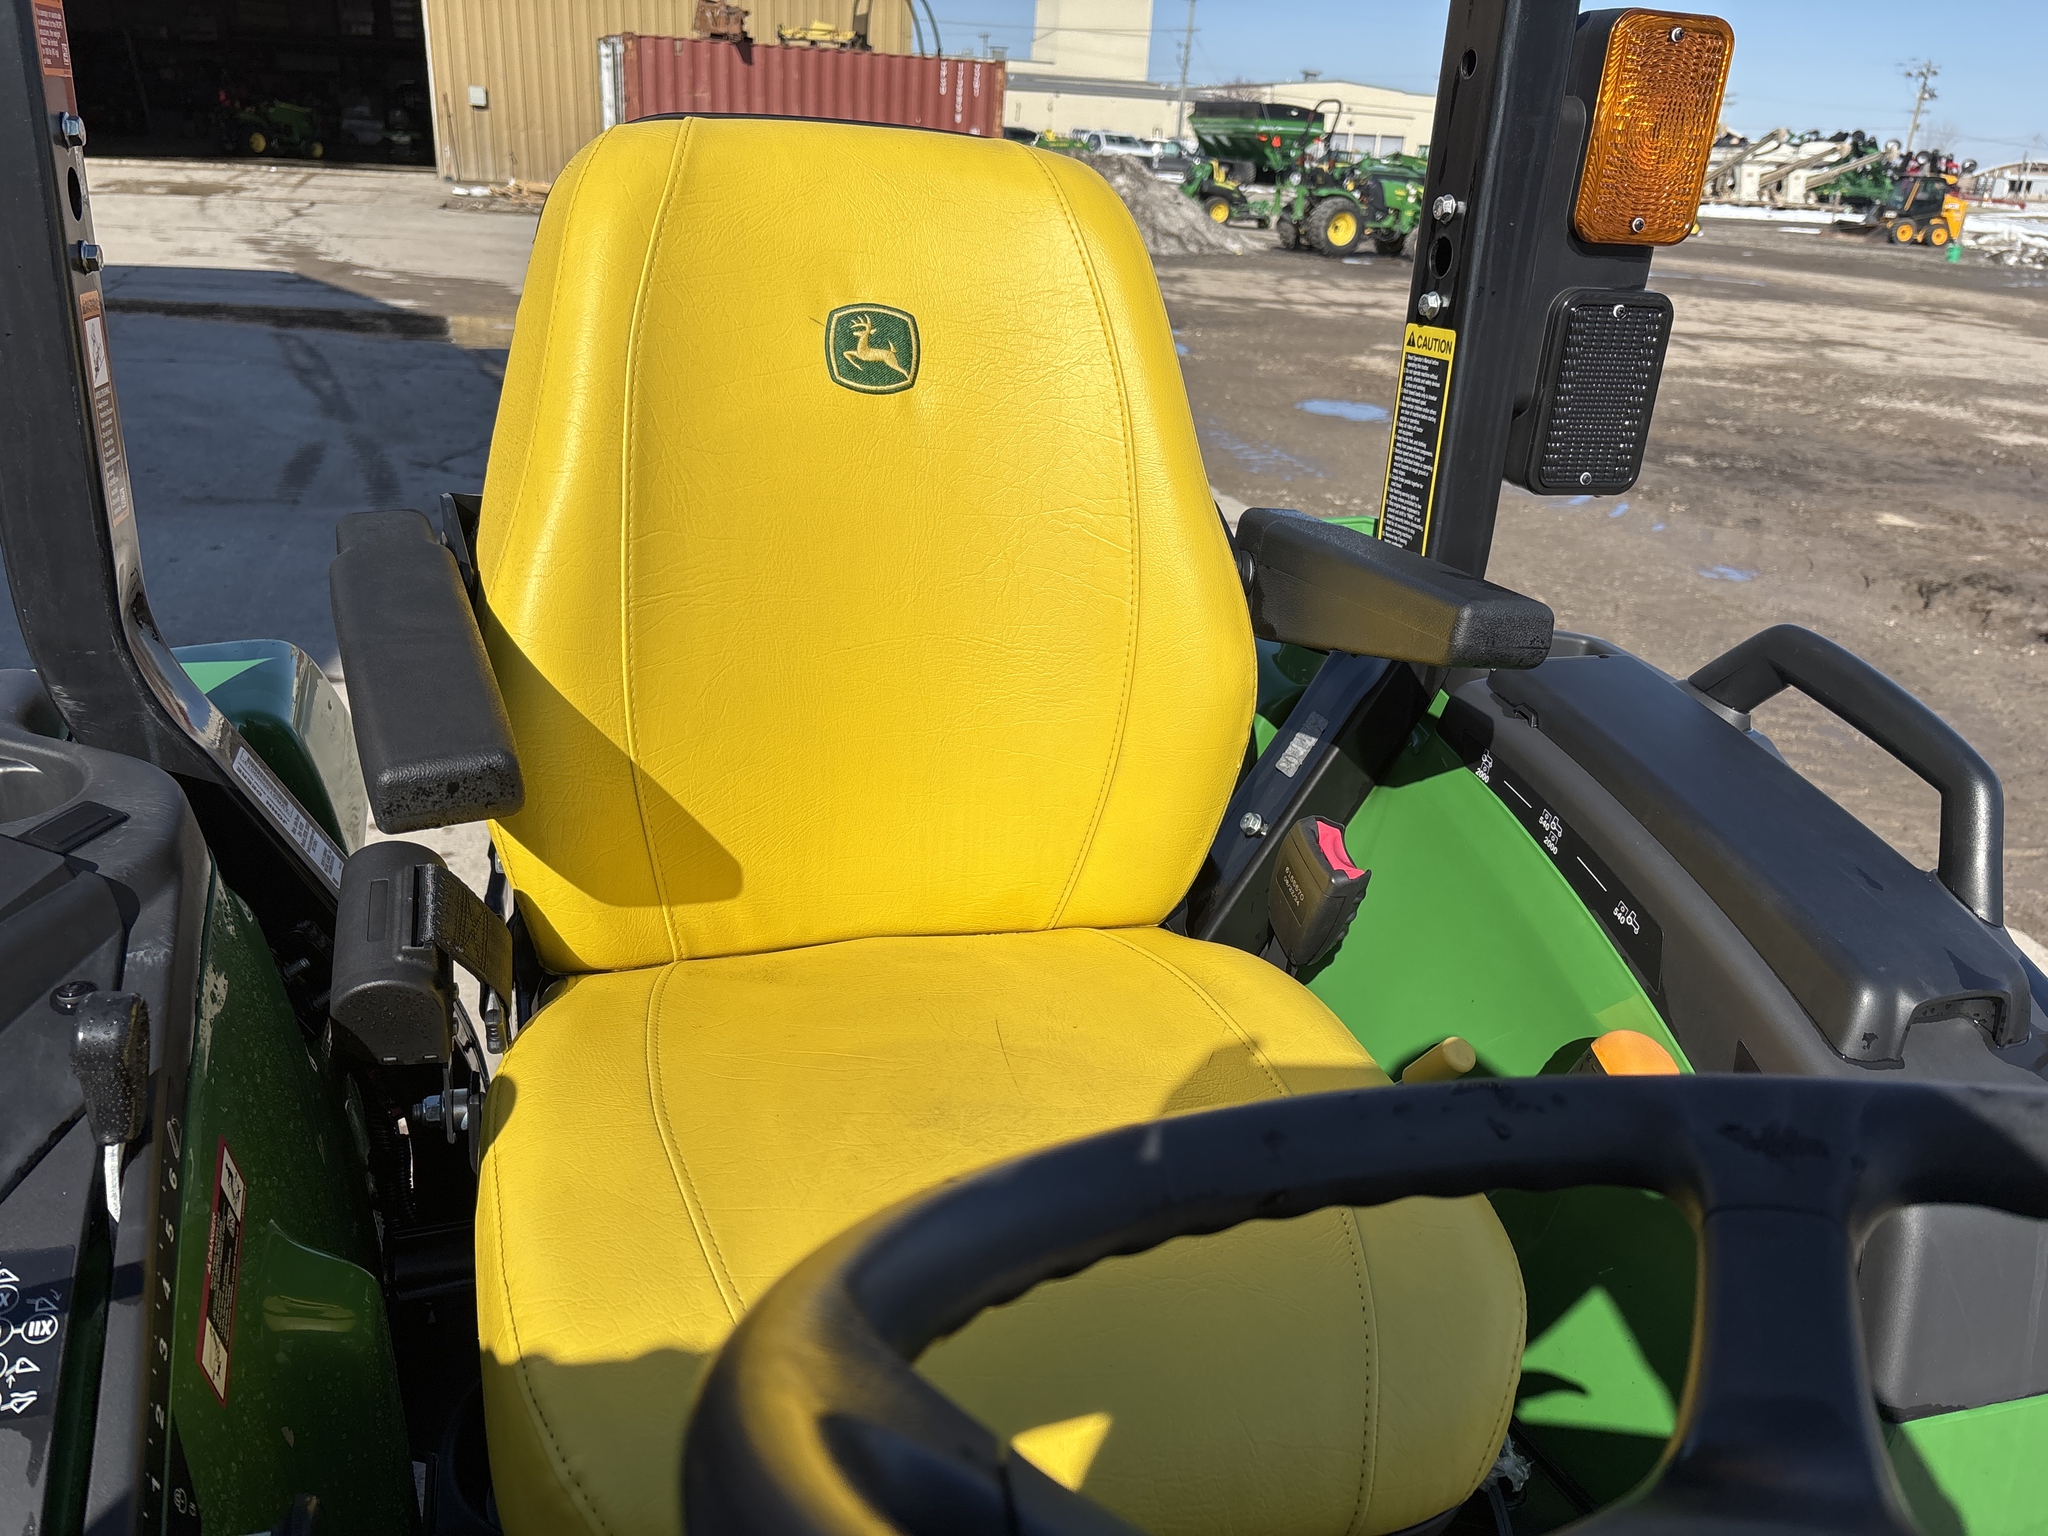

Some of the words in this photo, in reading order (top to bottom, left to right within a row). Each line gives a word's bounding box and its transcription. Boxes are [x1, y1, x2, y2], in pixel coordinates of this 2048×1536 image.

[1416, 334, 1453, 355] CAUTION
[1475, 767, 1490, 784] 2000
[1538, 816, 1550, 831] 540
[1543, 835, 1558, 855] 2000
[1612, 906, 1626, 925] 540
[168, 1167, 178, 1191] 6
[165, 1217, 175, 1244] 5
[162, 1276, 172, 1301] 4
[159, 1337, 169, 1362] 3
[154, 1403, 165, 1431] 2
